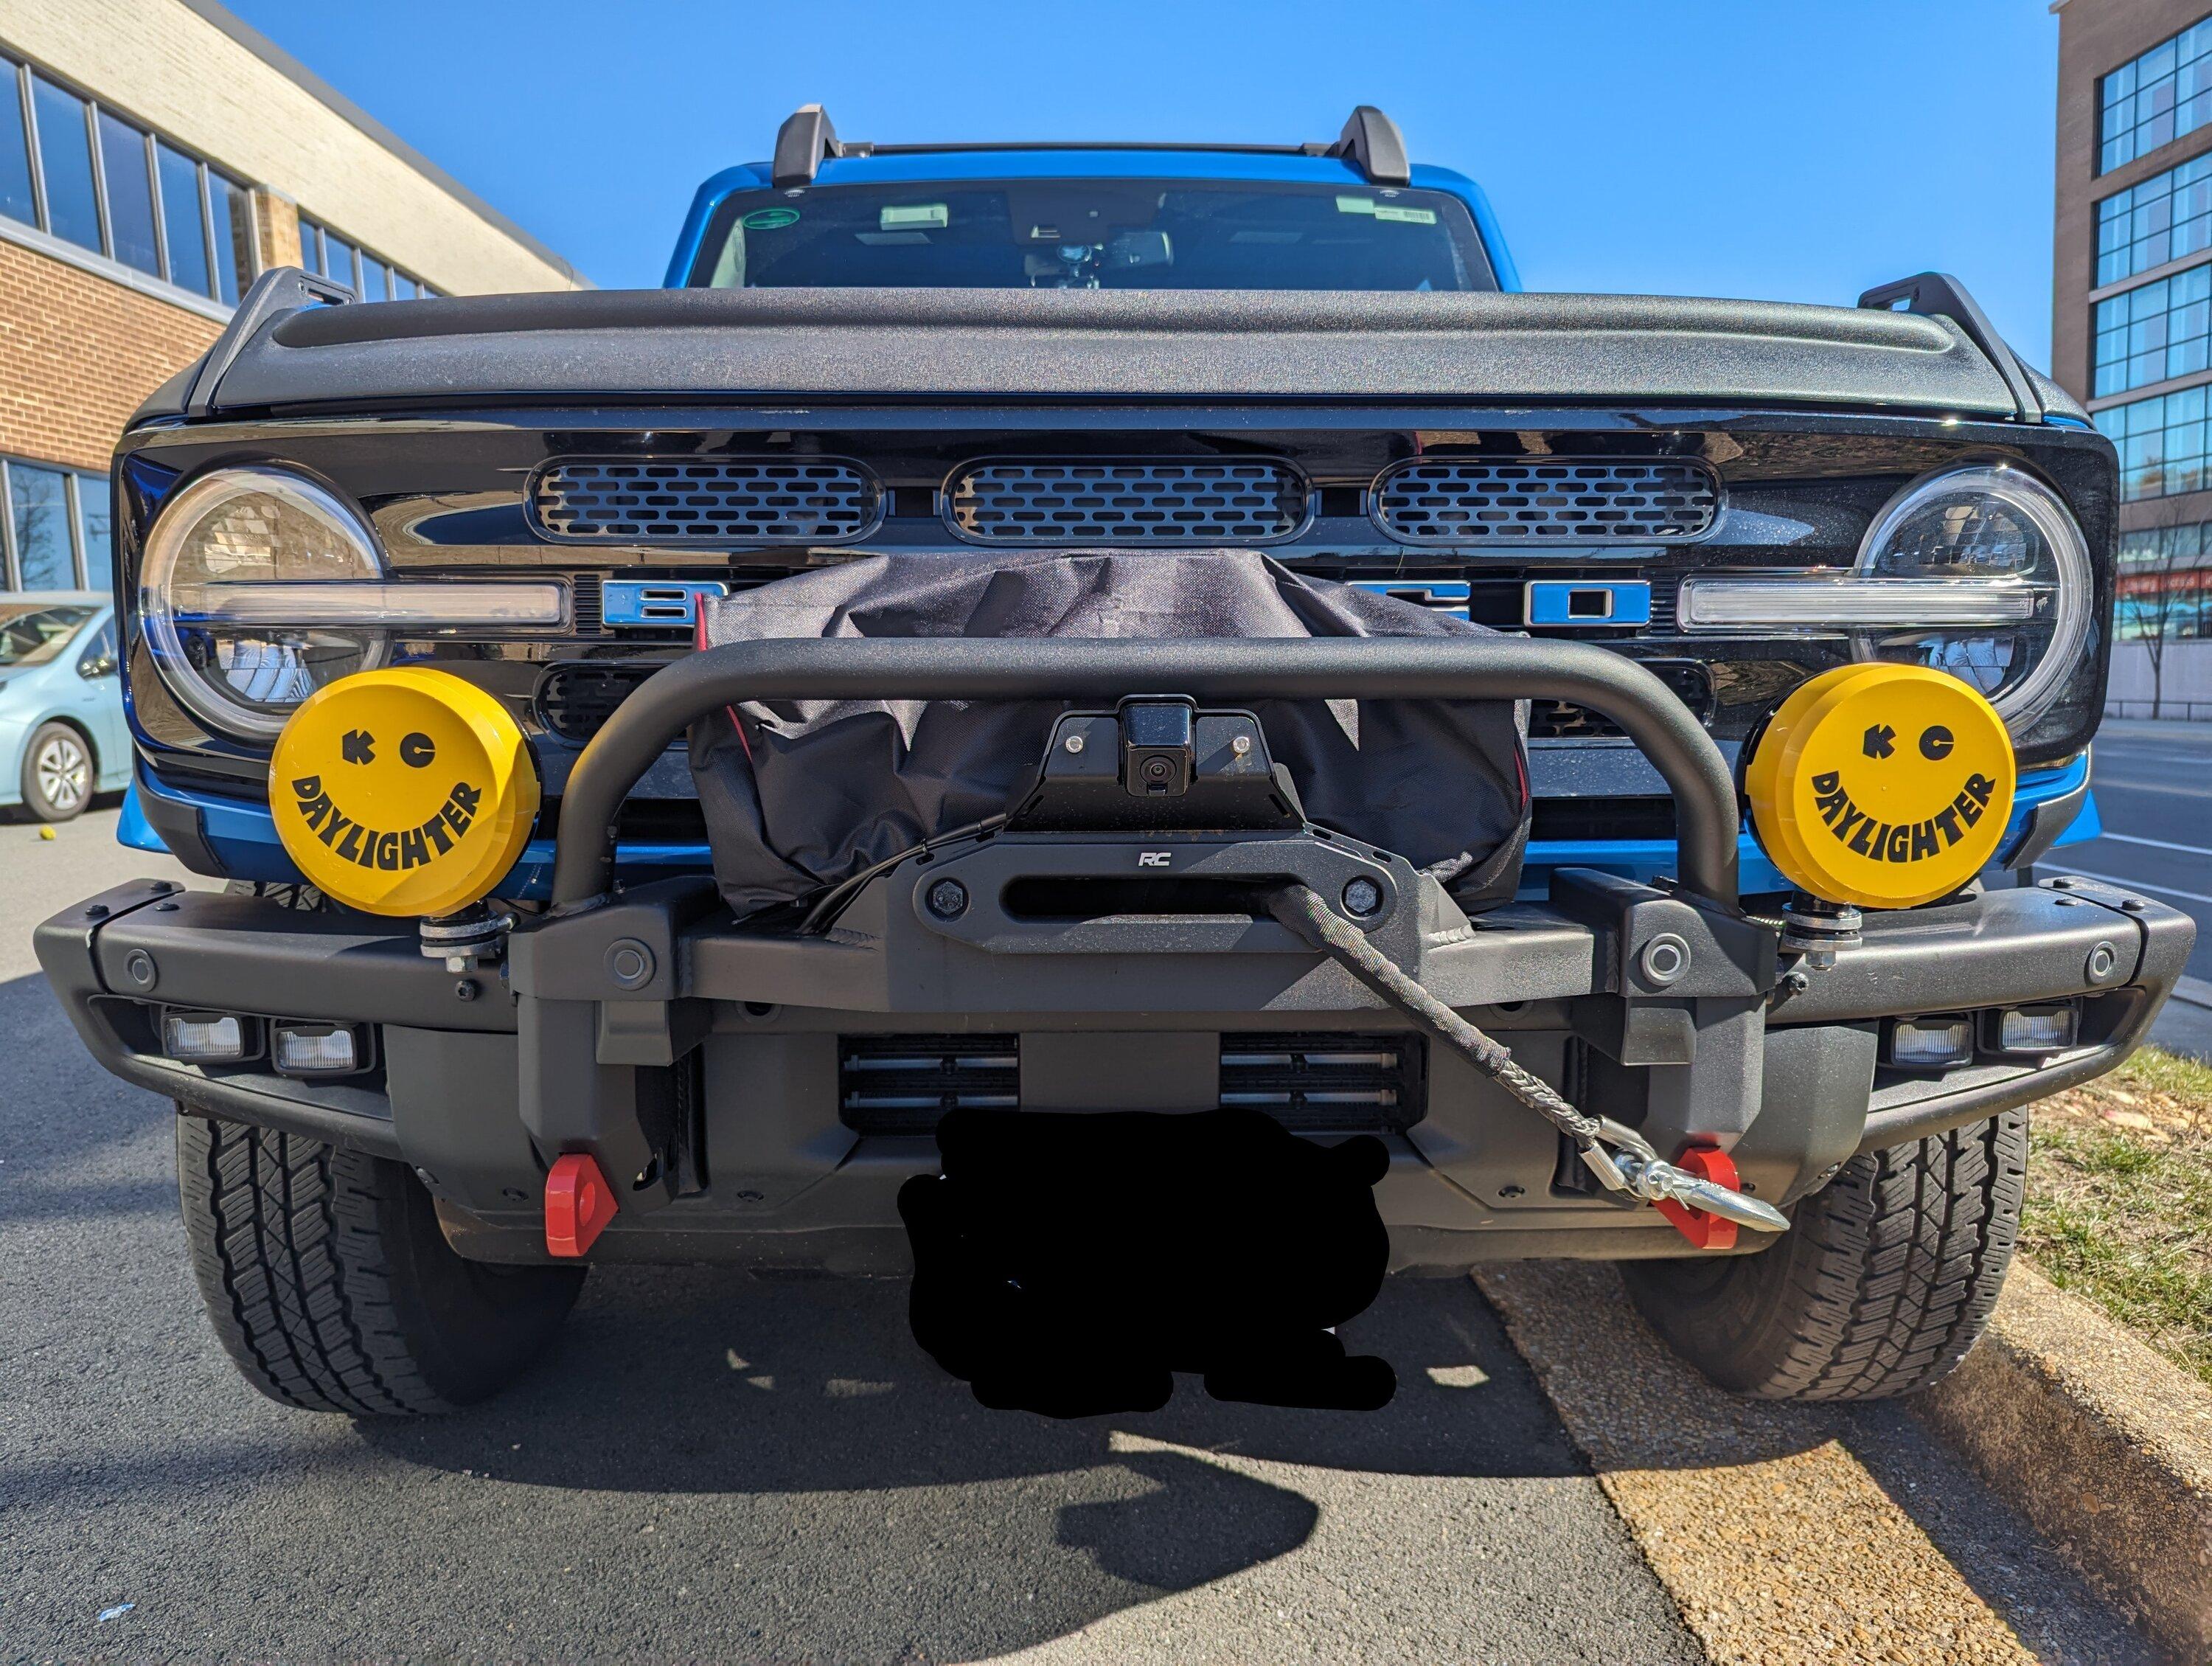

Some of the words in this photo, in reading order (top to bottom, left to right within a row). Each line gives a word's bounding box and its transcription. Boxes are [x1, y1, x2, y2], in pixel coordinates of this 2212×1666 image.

[292, 775, 481, 870] DAYLIGHTER
[1138, 852, 1172, 867] RC
[1812, 771, 1996, 863] DAYLIGHTER
